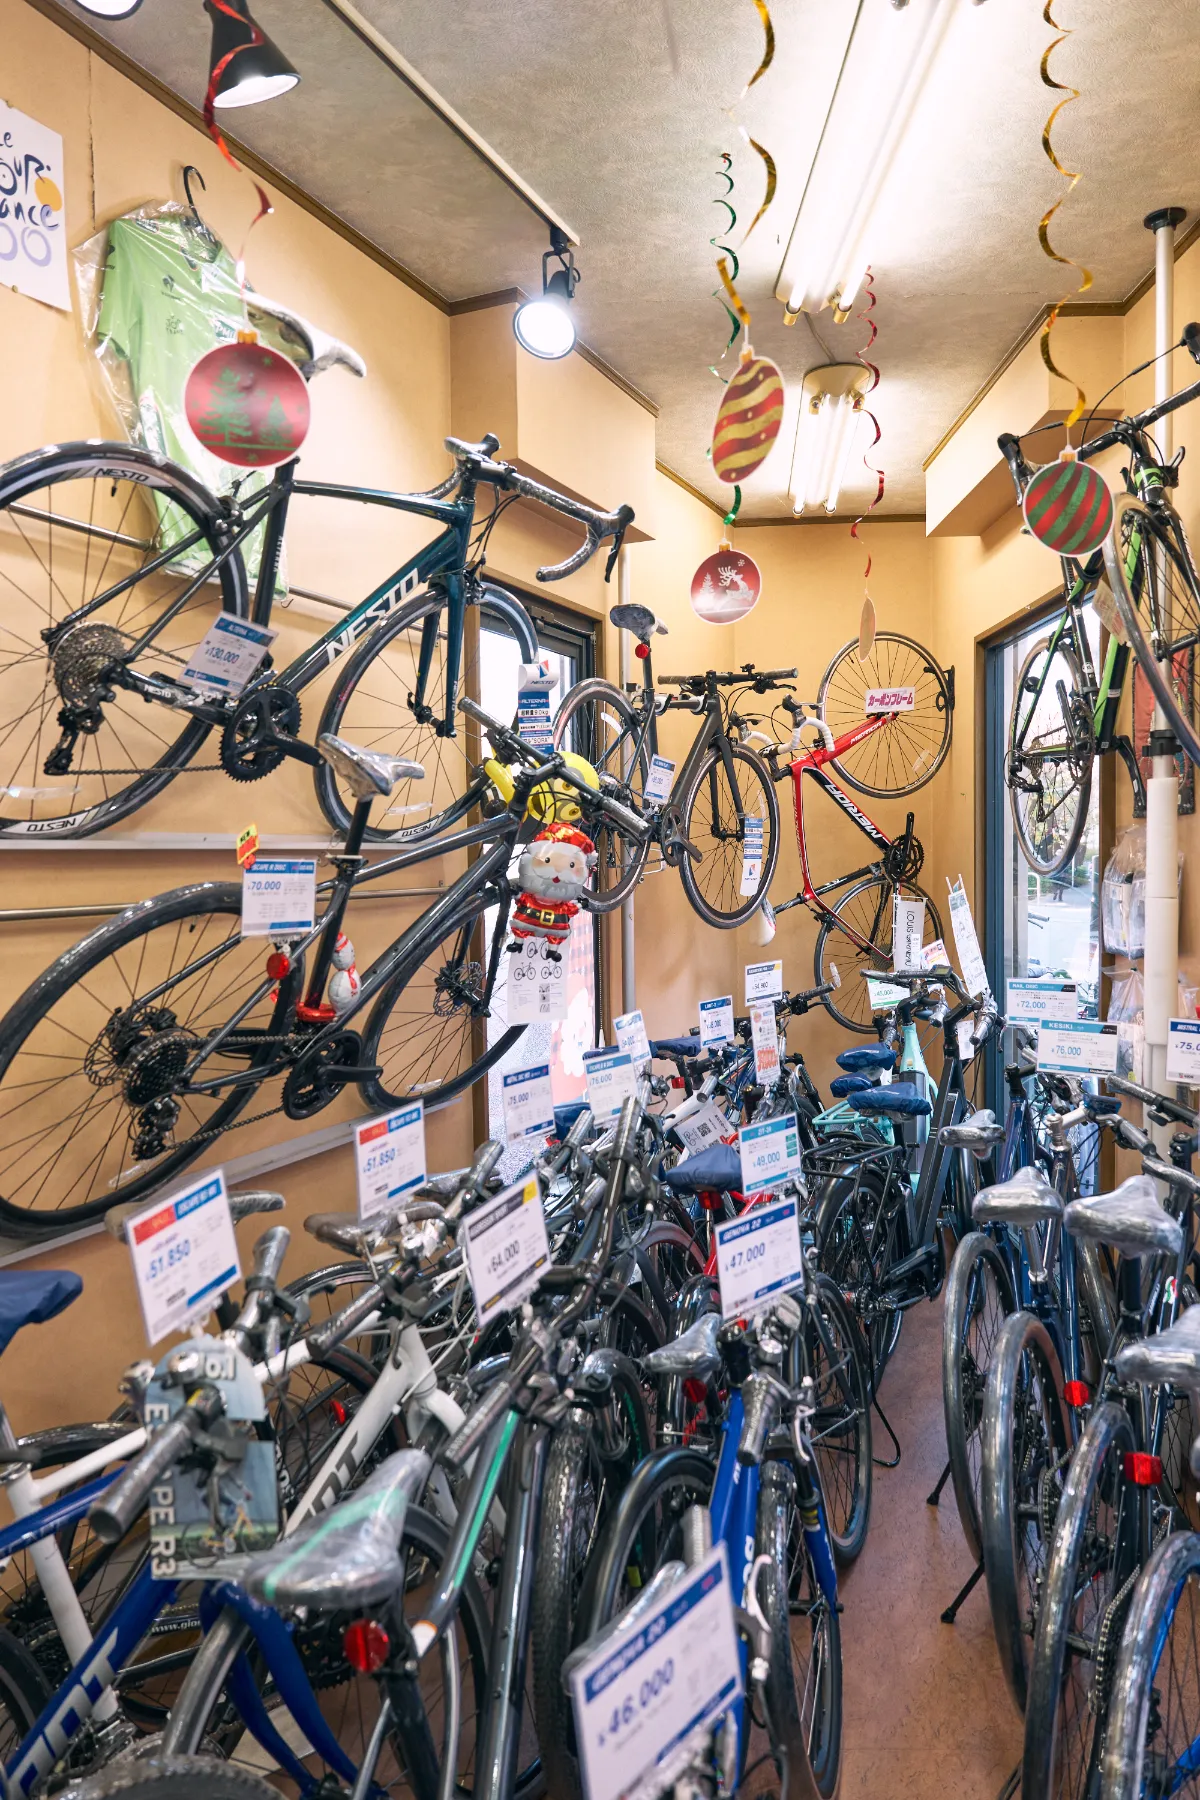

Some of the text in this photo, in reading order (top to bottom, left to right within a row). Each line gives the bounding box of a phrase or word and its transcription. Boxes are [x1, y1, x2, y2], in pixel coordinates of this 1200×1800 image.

[0, 198, 60, 231] ance
[95, 468, 149, 482] NESTO
[326, 568, 419, 664] NESTO
[144, 684, 172, 698] NESTO
[867, 691, 914, 707] カーボンフレーム
[824, 783, 883, 839] MERIDA
[27, 817, 77, 833] NESTO
[401, 823, 432, 838] NESTO
[906, 910, 915, 933] LOUIS
[1048, 1022, 1073, 1030] KESIKI
